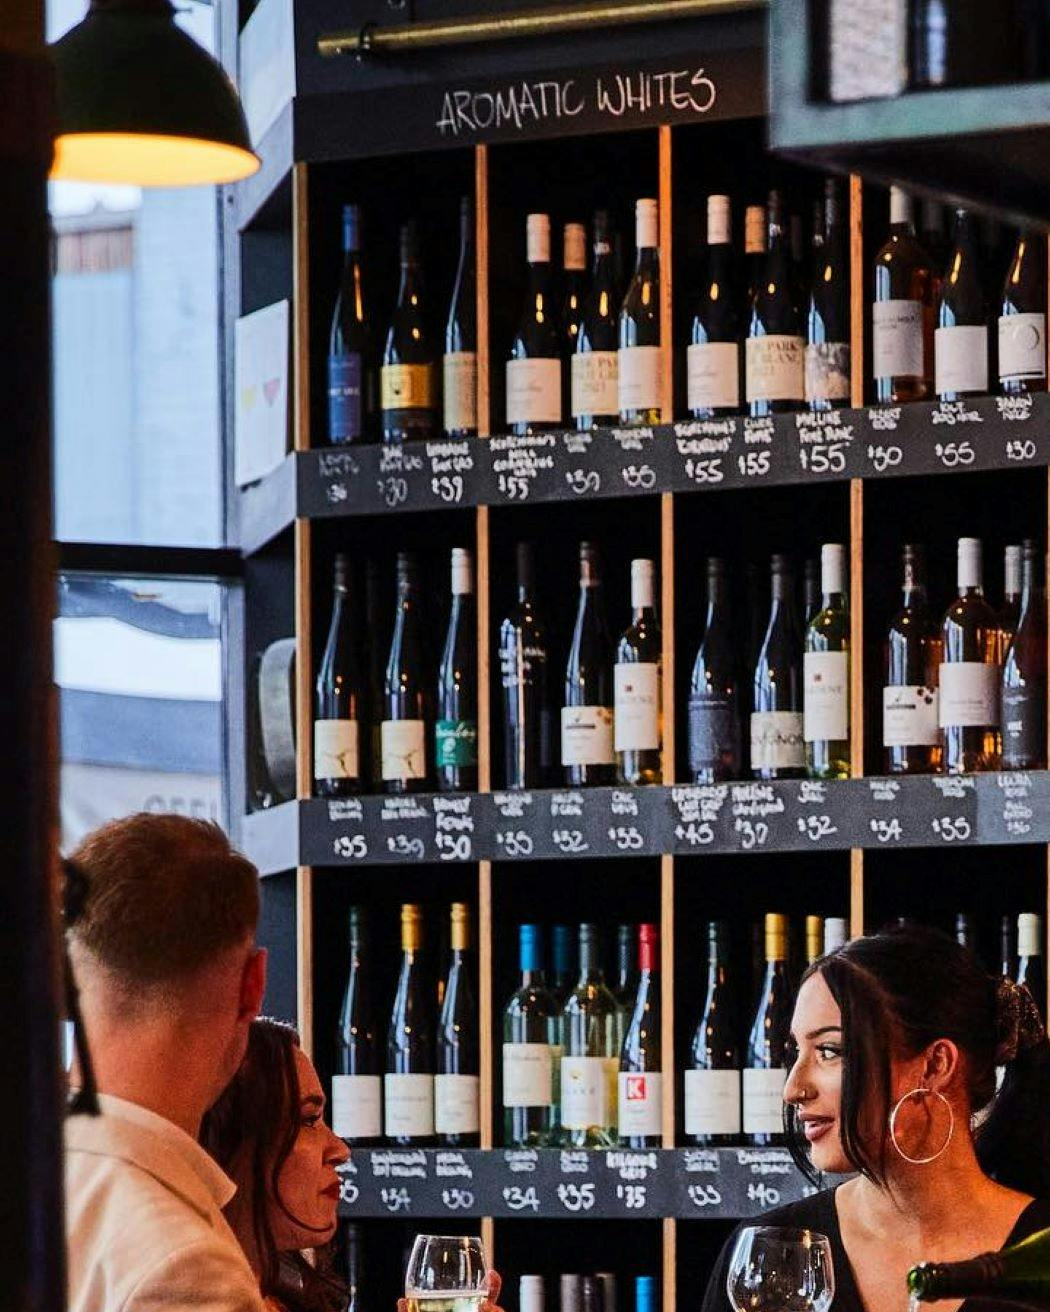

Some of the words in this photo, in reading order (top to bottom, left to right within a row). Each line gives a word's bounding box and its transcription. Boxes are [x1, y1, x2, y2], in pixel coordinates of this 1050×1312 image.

[435, 80, 585, 135] AROMATIC
[598, 68, 717, 114] WHITES
[502, 1186, 541, 1212] $34
[556, 1183, 596, 1211] $35
